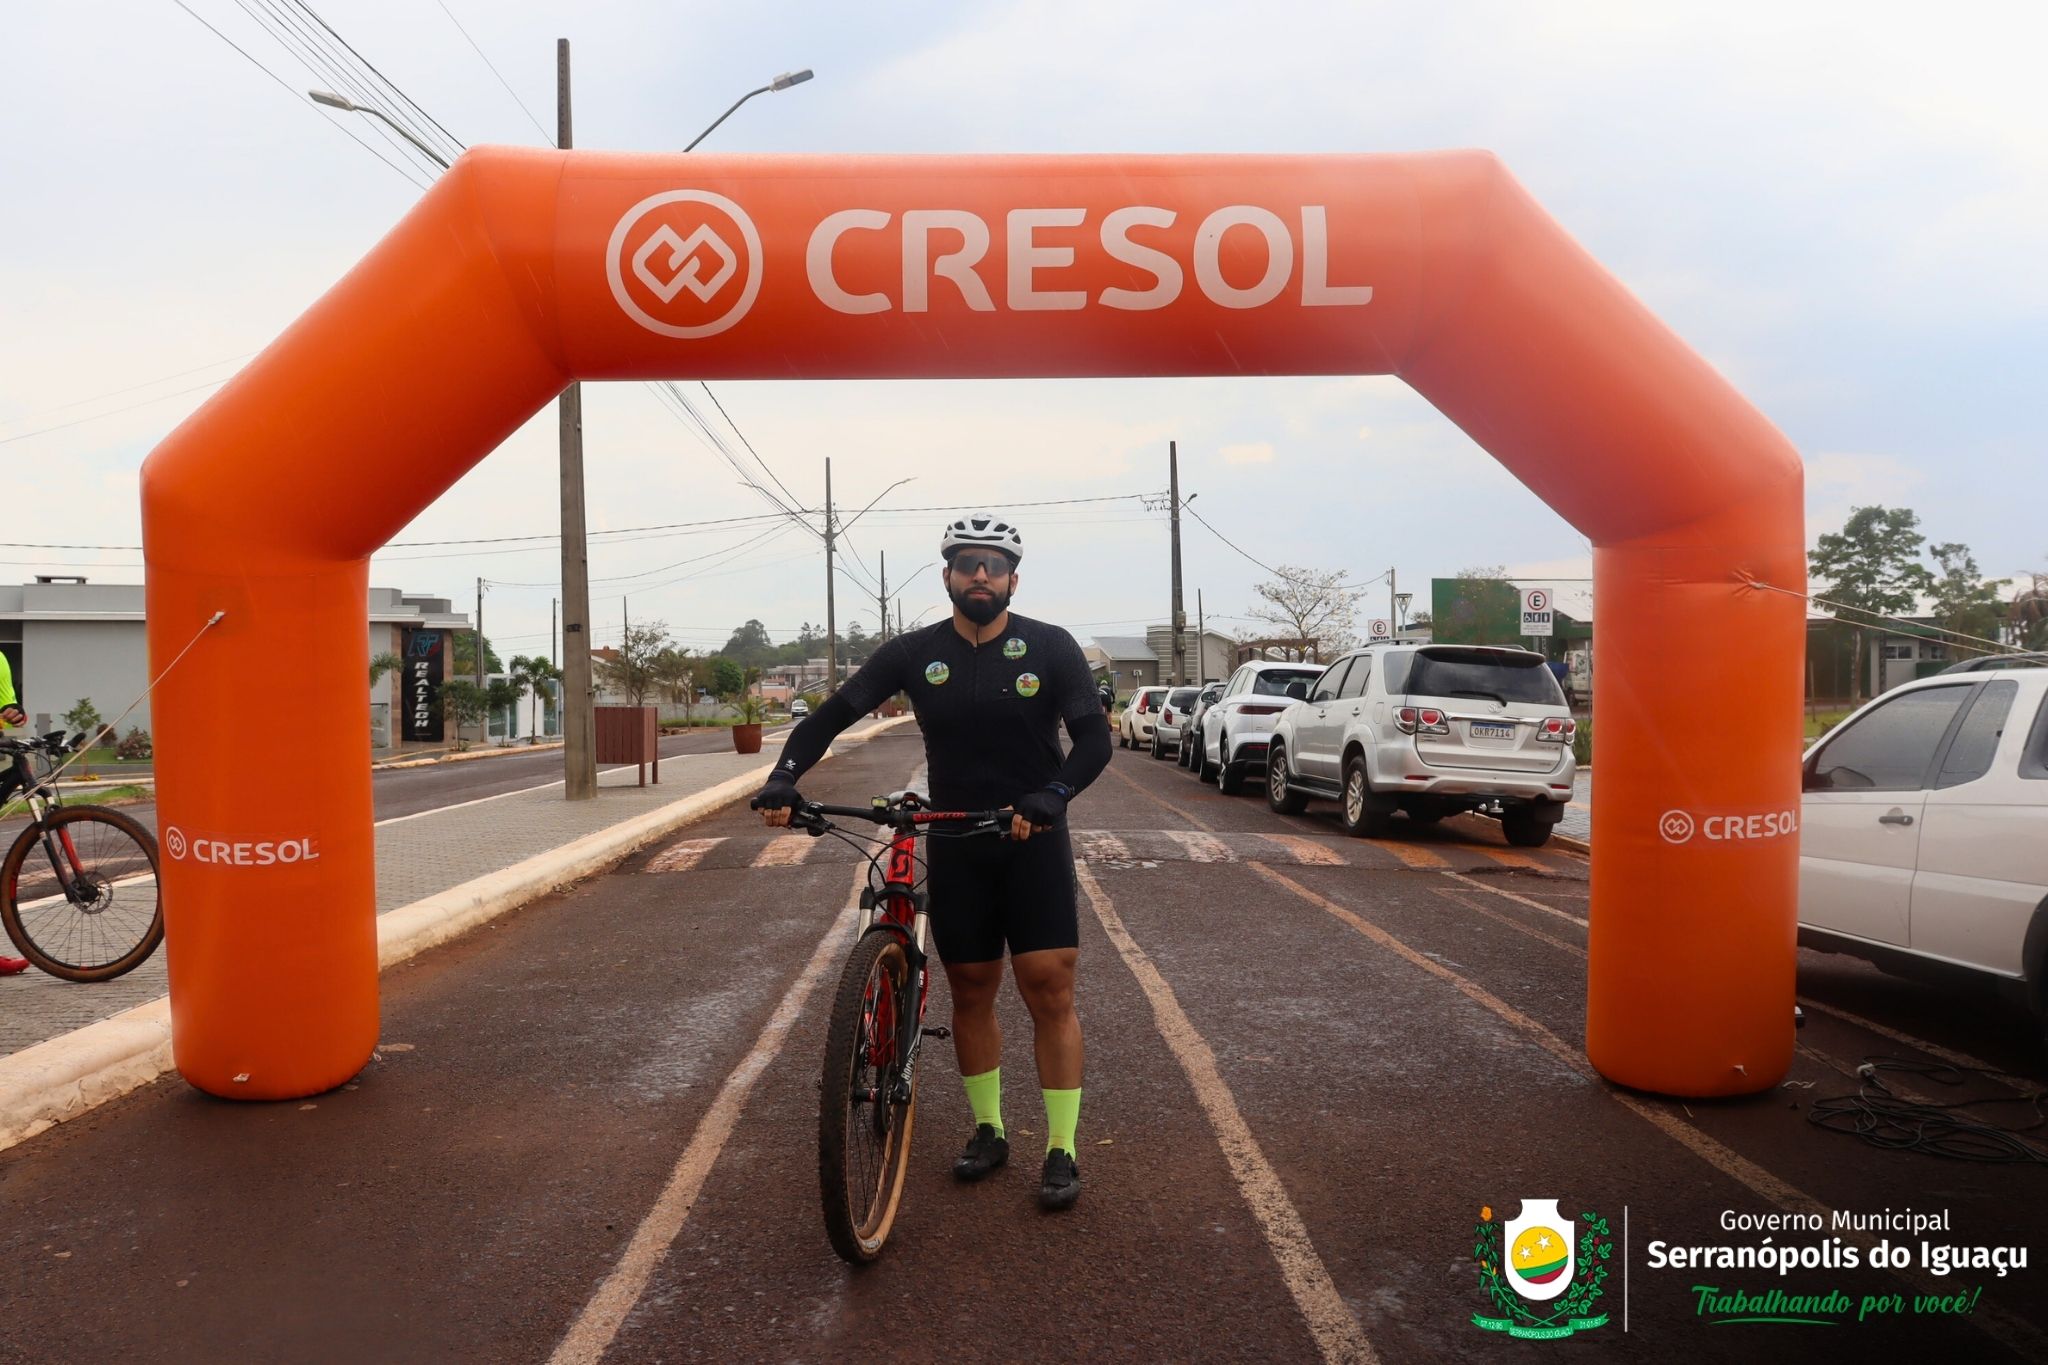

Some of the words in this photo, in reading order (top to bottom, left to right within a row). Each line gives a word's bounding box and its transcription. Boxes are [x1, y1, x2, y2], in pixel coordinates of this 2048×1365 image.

[805, 205, 1373, 314] CRESOL
[1533, 595, 1541, 606] E
[1376, 624, 1383, 632] E
[1703, 810, 1798, 840] CRESOL
[193, 838, 319, 865] CRESOL
